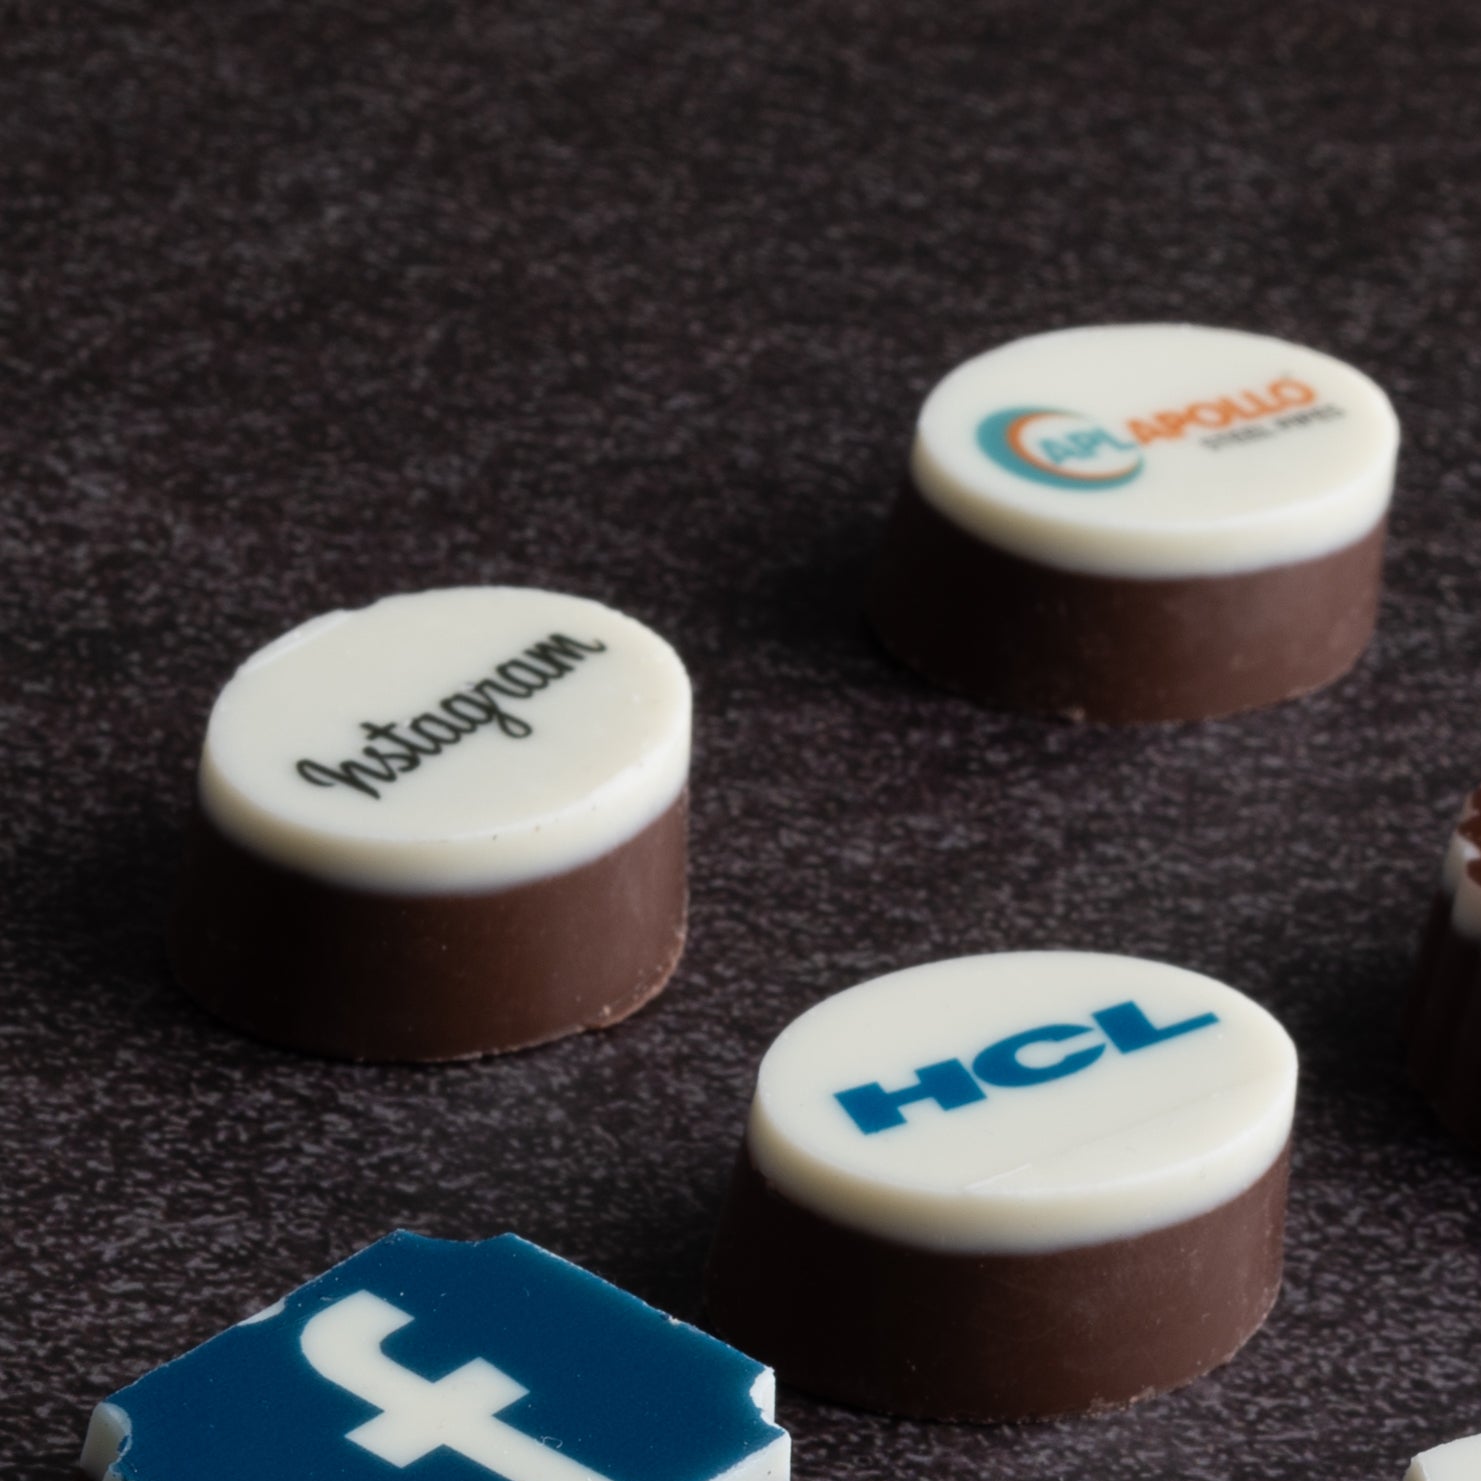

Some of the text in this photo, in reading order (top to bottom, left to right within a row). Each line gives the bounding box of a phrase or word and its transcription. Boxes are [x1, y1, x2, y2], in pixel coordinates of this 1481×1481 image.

[1127, 378, 1318, 446] APOLLO
[296, 633, 606, 799] Instagram
[833, 1001, 1219, 1136] HCL
